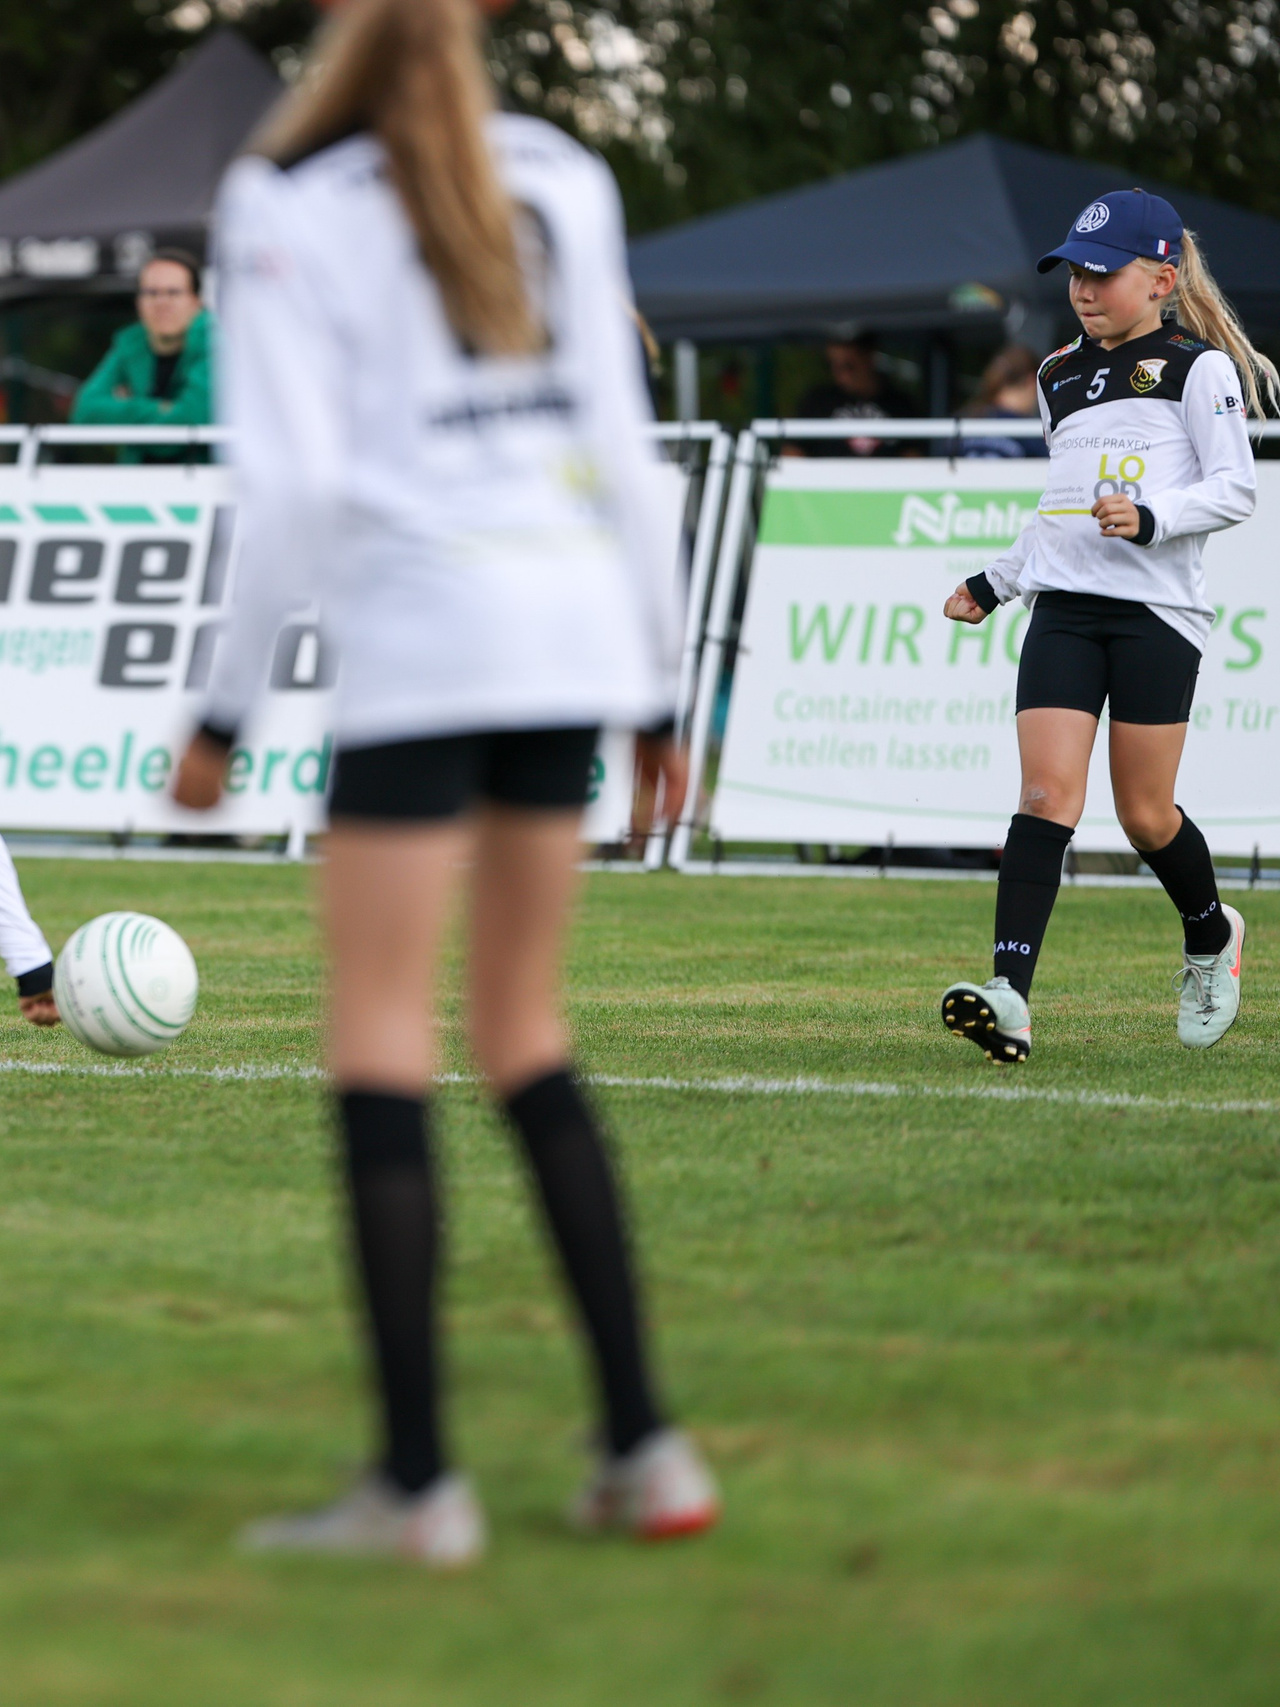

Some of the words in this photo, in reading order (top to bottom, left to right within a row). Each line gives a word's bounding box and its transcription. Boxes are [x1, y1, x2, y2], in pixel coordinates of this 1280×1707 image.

[1086, 367, 1111, 400] 5
[1102, 437, 1151, 451] PRAXEN
[788, 601, 926, 666] WIR
[773, 688, 938, 725] Container
[1224, 698, 1280, 732] Tür
[766, 735, 879, 769] stellen
[885, 735, 991, 771] lassen
